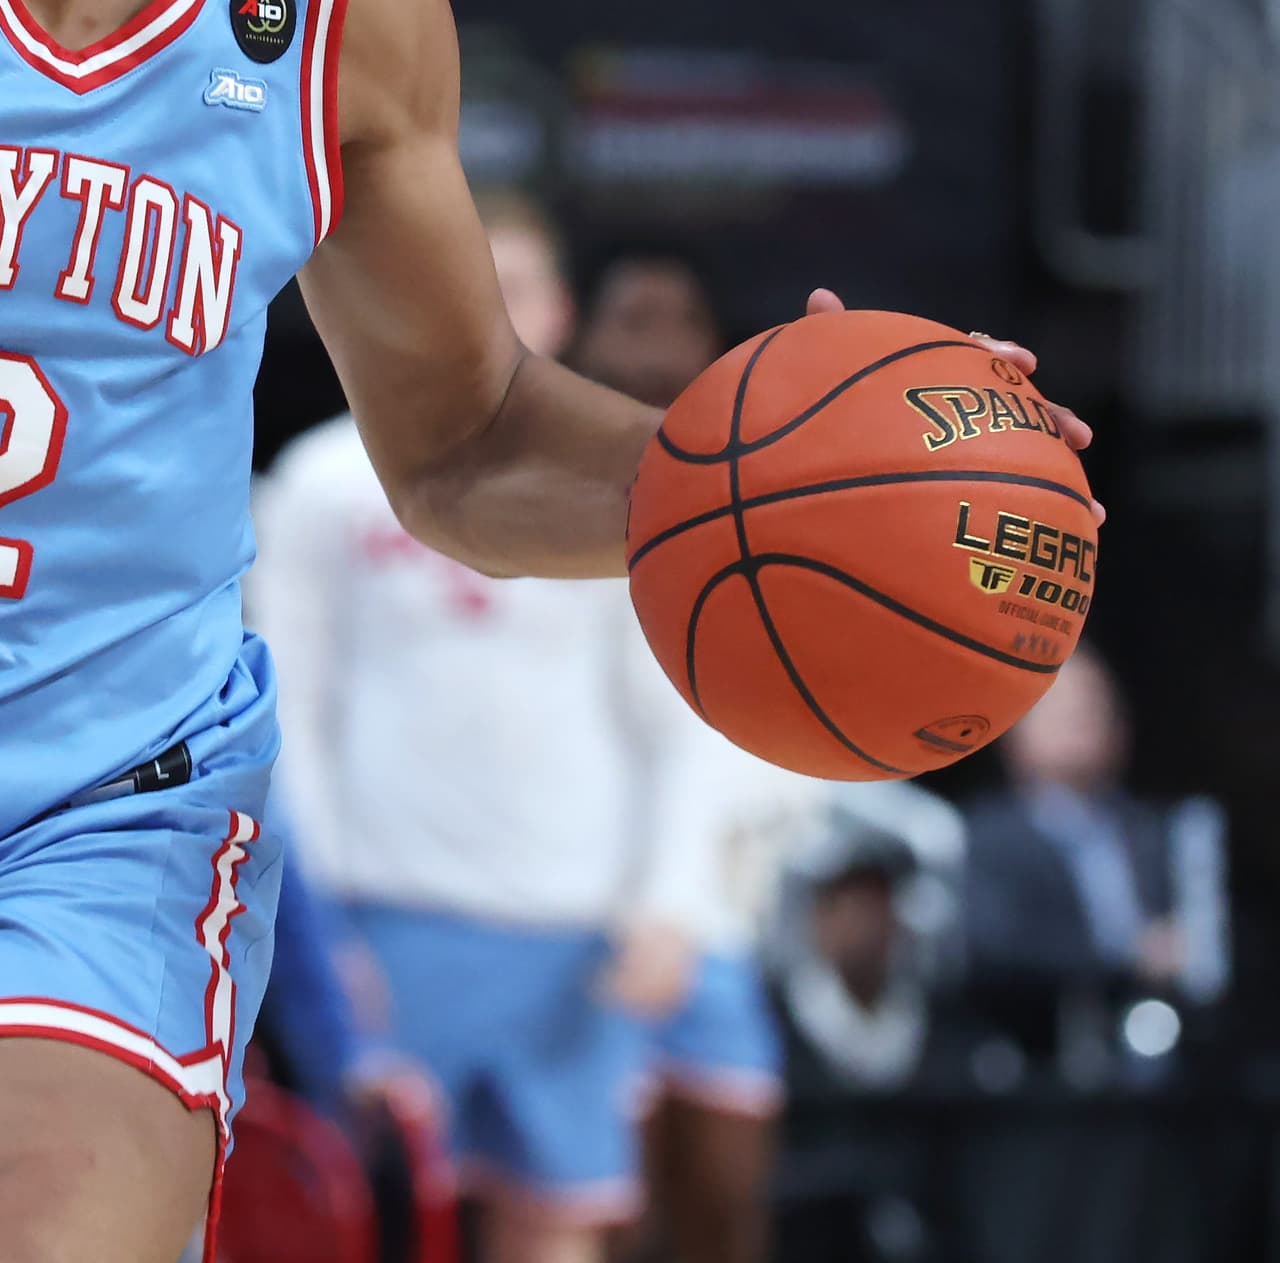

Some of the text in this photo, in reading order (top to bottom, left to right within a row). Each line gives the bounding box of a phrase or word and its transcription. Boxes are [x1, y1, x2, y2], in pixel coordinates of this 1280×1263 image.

[209, 74, 265, 104] A10
[952, 501, 1096, 583] LEGAC
[971, 559, 1091, 616] TF 1000
[154, 759, 170, 781] L
